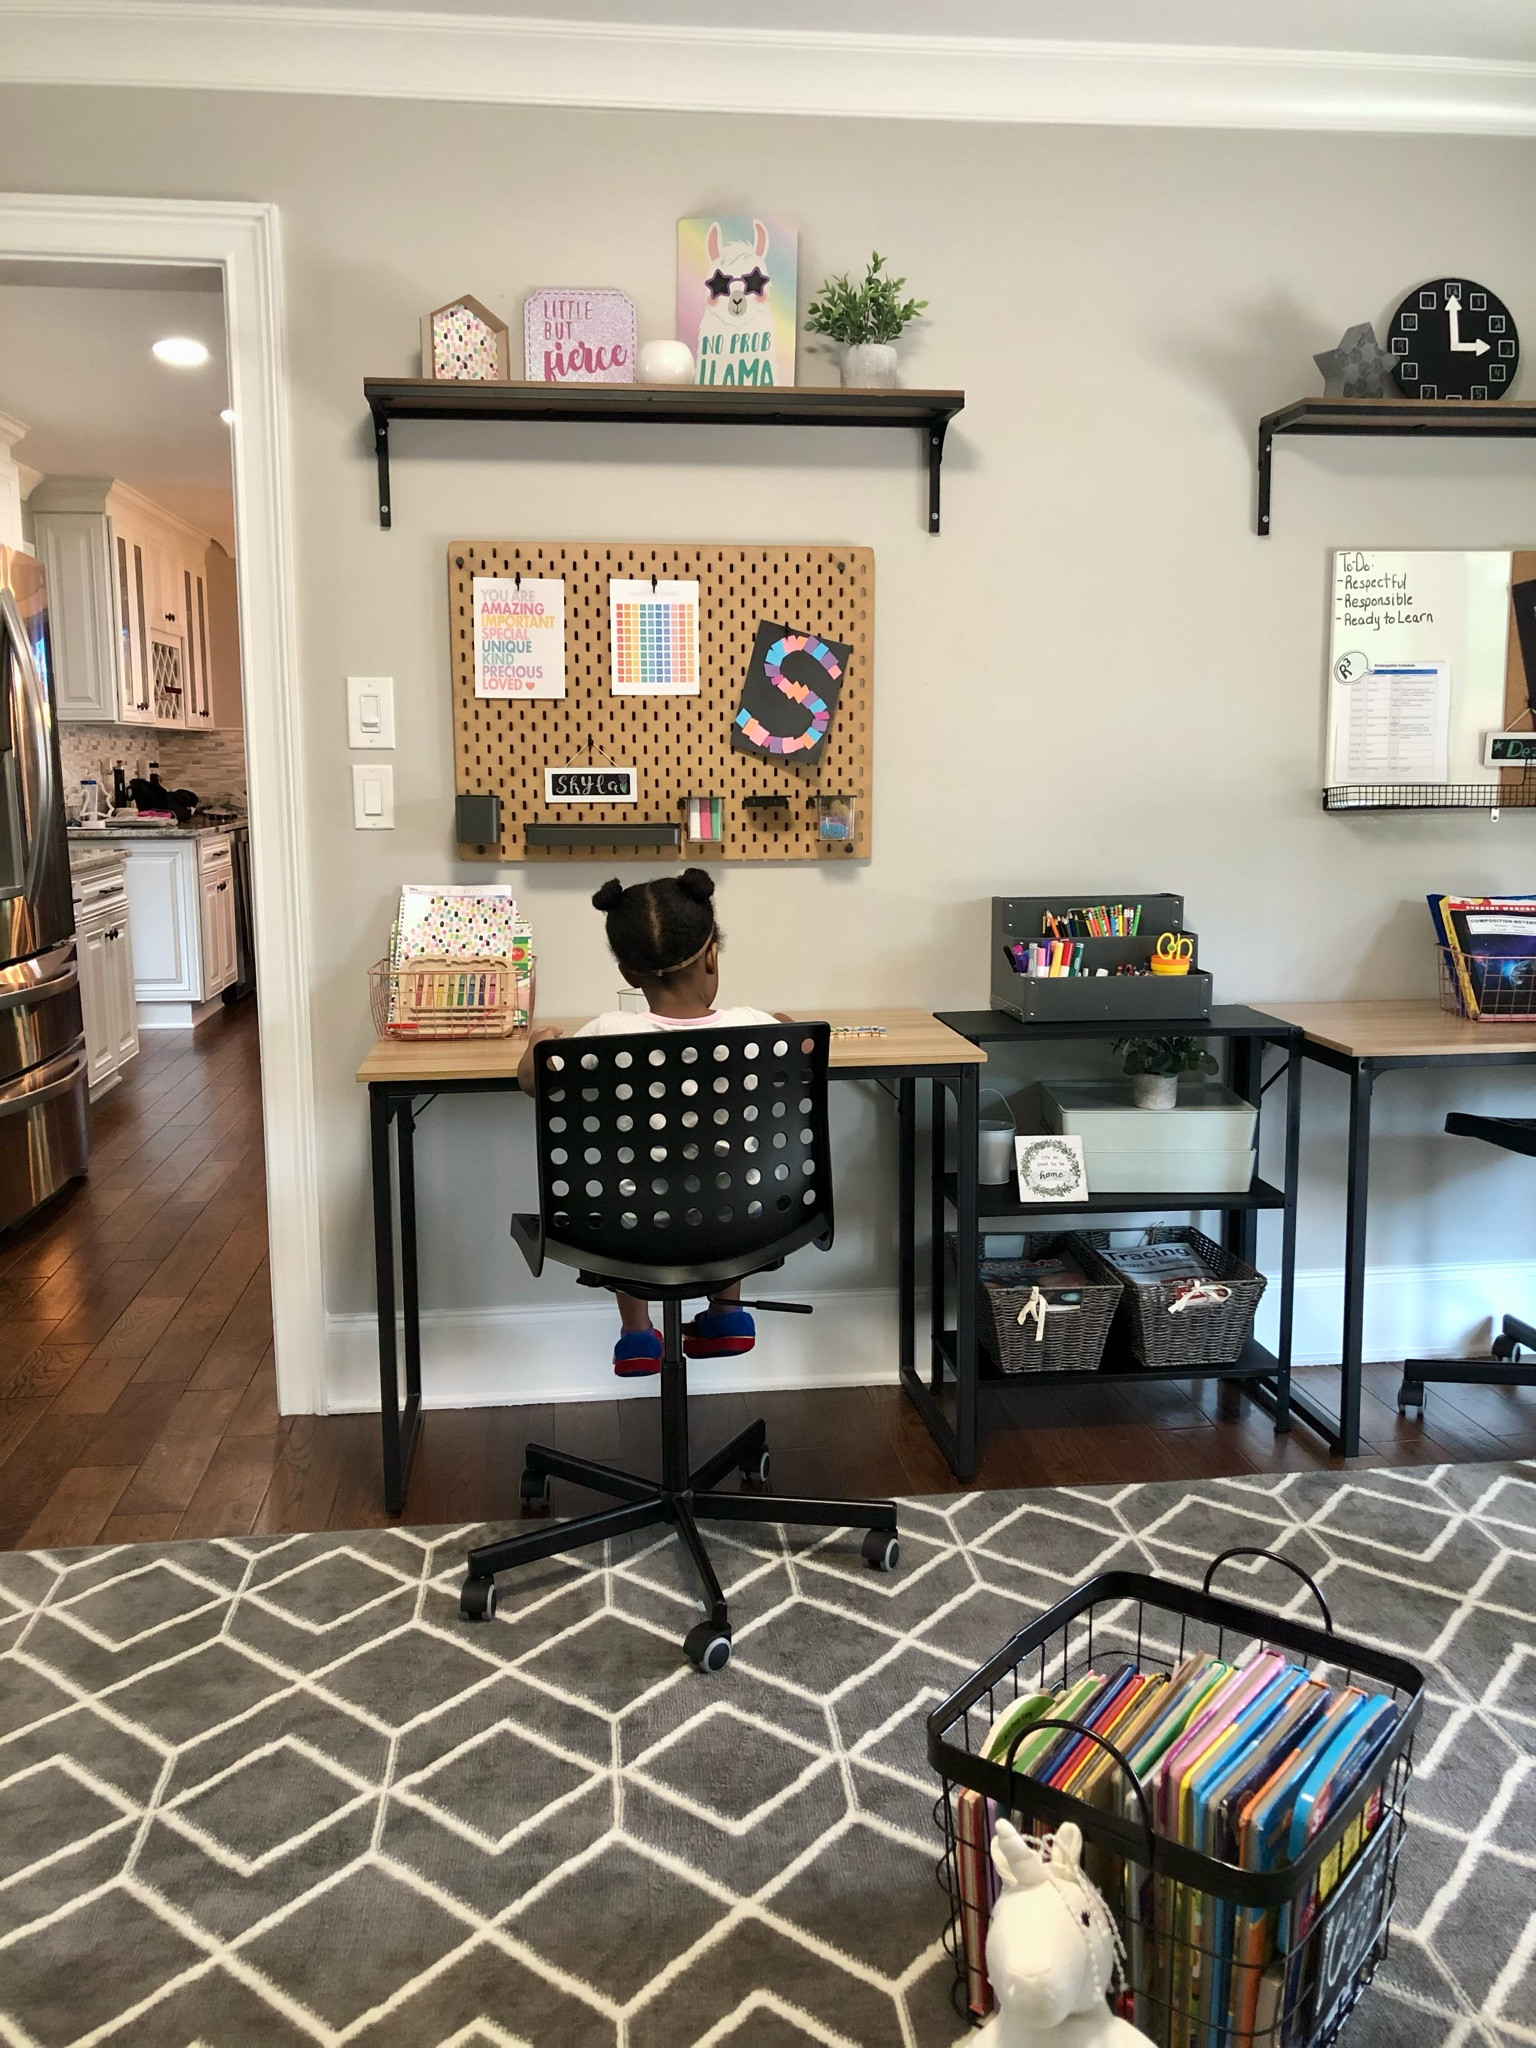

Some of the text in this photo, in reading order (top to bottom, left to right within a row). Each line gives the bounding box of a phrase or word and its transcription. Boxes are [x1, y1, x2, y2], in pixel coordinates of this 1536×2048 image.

[543, 300, 592, 320] LITTLE
[544, 321, 572, 340] BUT
[702, 331, 771, 355] NO PROB
[543, 341, 627, 381] fierce
[1338, 552, 1374, 572] To-Do:
[480, 589, 535, 602] YOU ARE
[481, 602, 544, 615] AMAZING
[481, 615, 555, 628] IMPORTANT
[1383, 611, 1395, 624] to
[1397, 610, 1433, 623] Learn
[481, 627, 530, 640] SPECIAL
[482, 640, 532, 653] UNIQUE
[482, 653, 514, 665] KIND
[482, 665, 543, 678] PRECIOUS
[482, 678, 523, 690] LOVED
[735, 635, 842, 754] S
[555, 775, 619, 795] Skyla
[1039, 1170, 1065, 1180] home
[1102, 1246, 1190, 1262] Tracing
